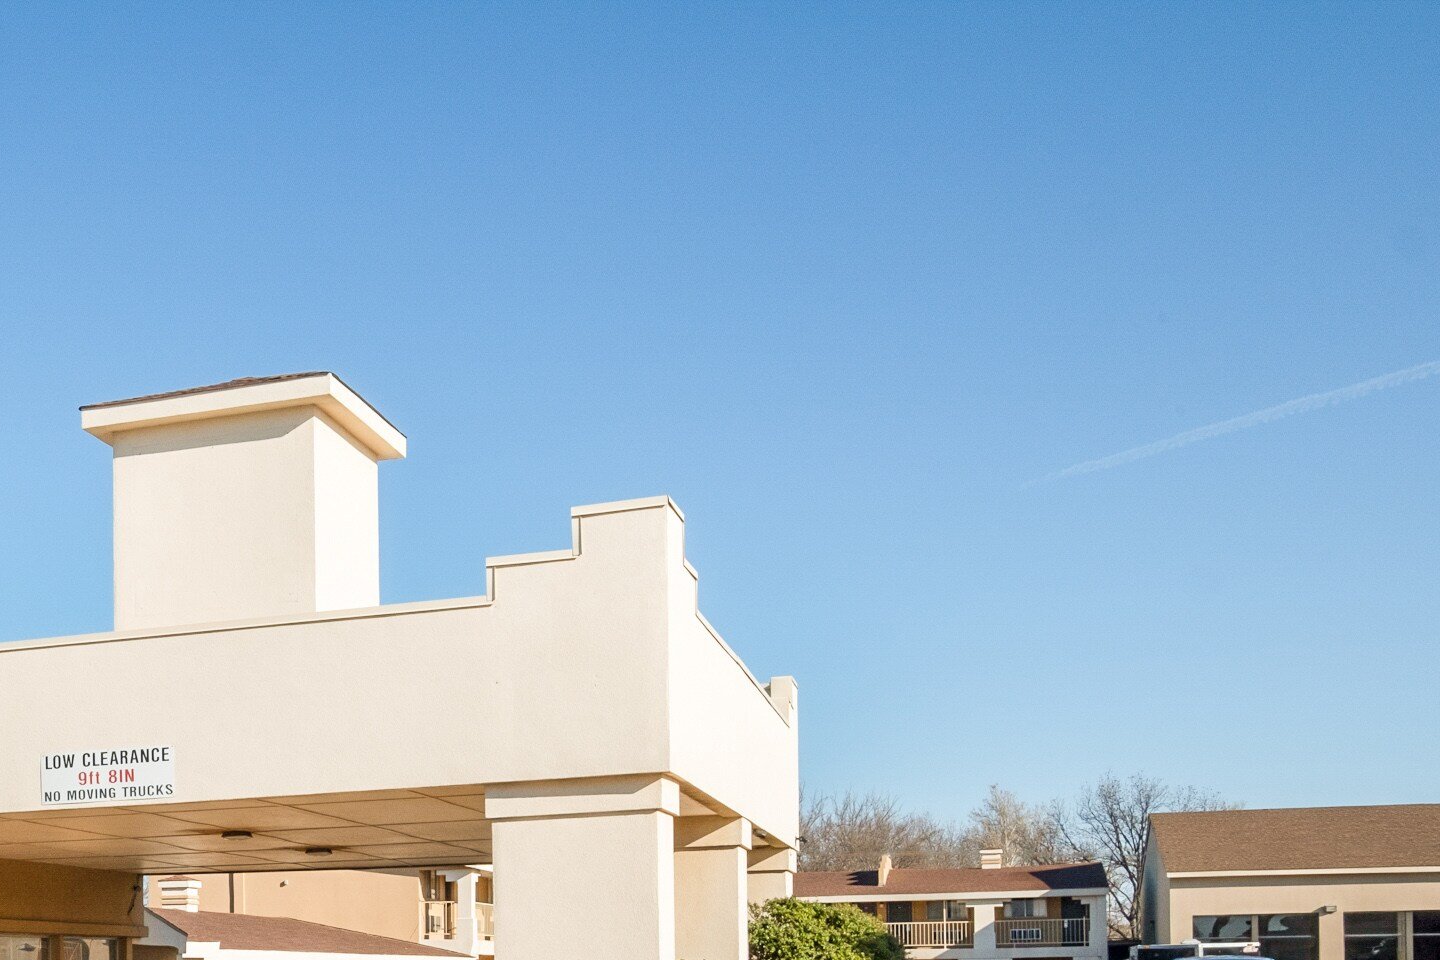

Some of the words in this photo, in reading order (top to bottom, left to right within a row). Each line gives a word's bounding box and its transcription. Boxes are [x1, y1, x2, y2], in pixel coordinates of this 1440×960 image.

[45, 754, 75, 769] LOW
[82, 747, 170, 767] CLEARANCE
[108, 768, 135, 783] 8IN
[44, 791, 61, 802] NO
[67, 787, 116, 801] MOVING
[122, 783, 173, 798] TRUCKS
